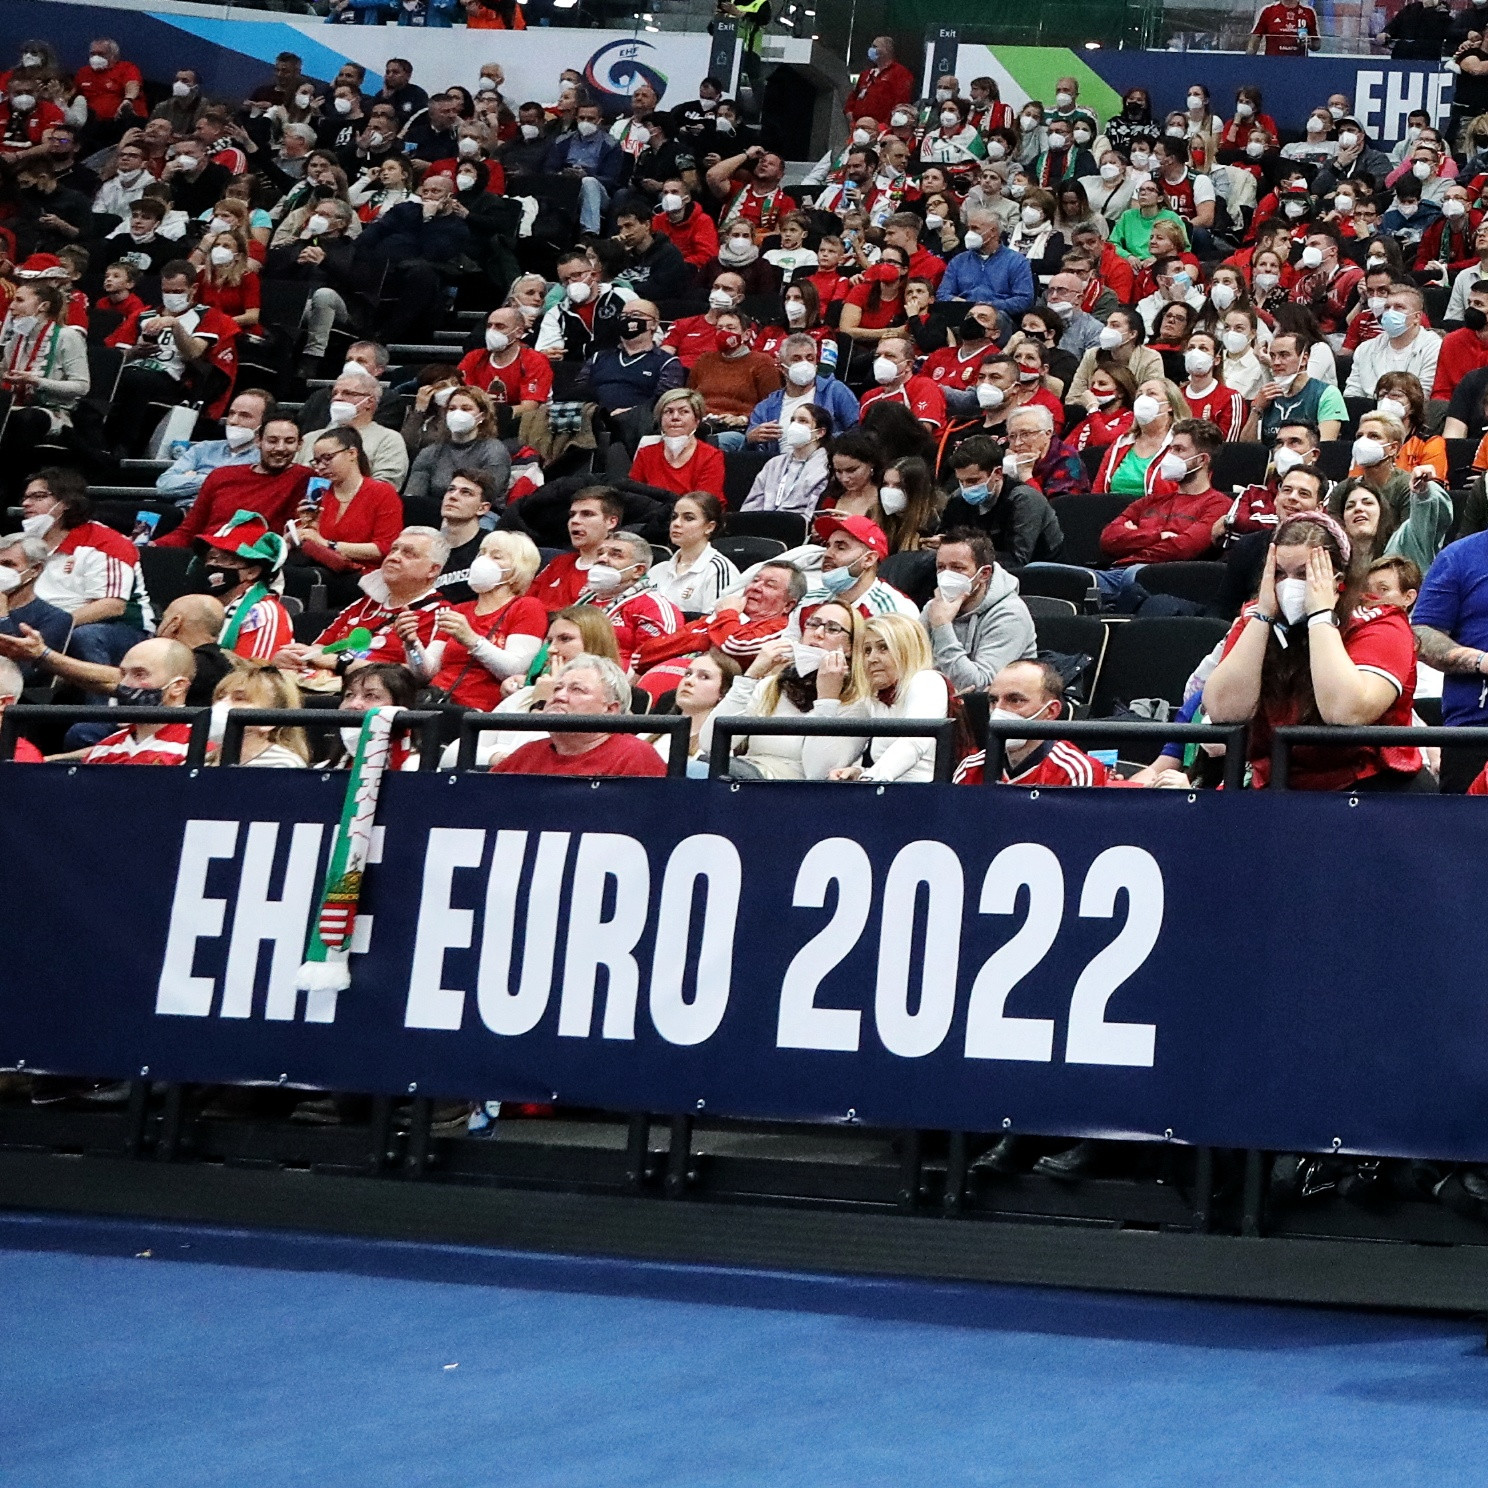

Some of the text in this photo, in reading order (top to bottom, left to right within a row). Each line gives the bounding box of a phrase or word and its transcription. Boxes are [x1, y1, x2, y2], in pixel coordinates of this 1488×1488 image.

[718, 22, 735, 32] Exit
[939, 28, 957, 38] Exit
[1356, 71, 1453, 141] EHF
[405, 827, 742, 1046] EURO
[777, 837, 1164, 1066] 2022
